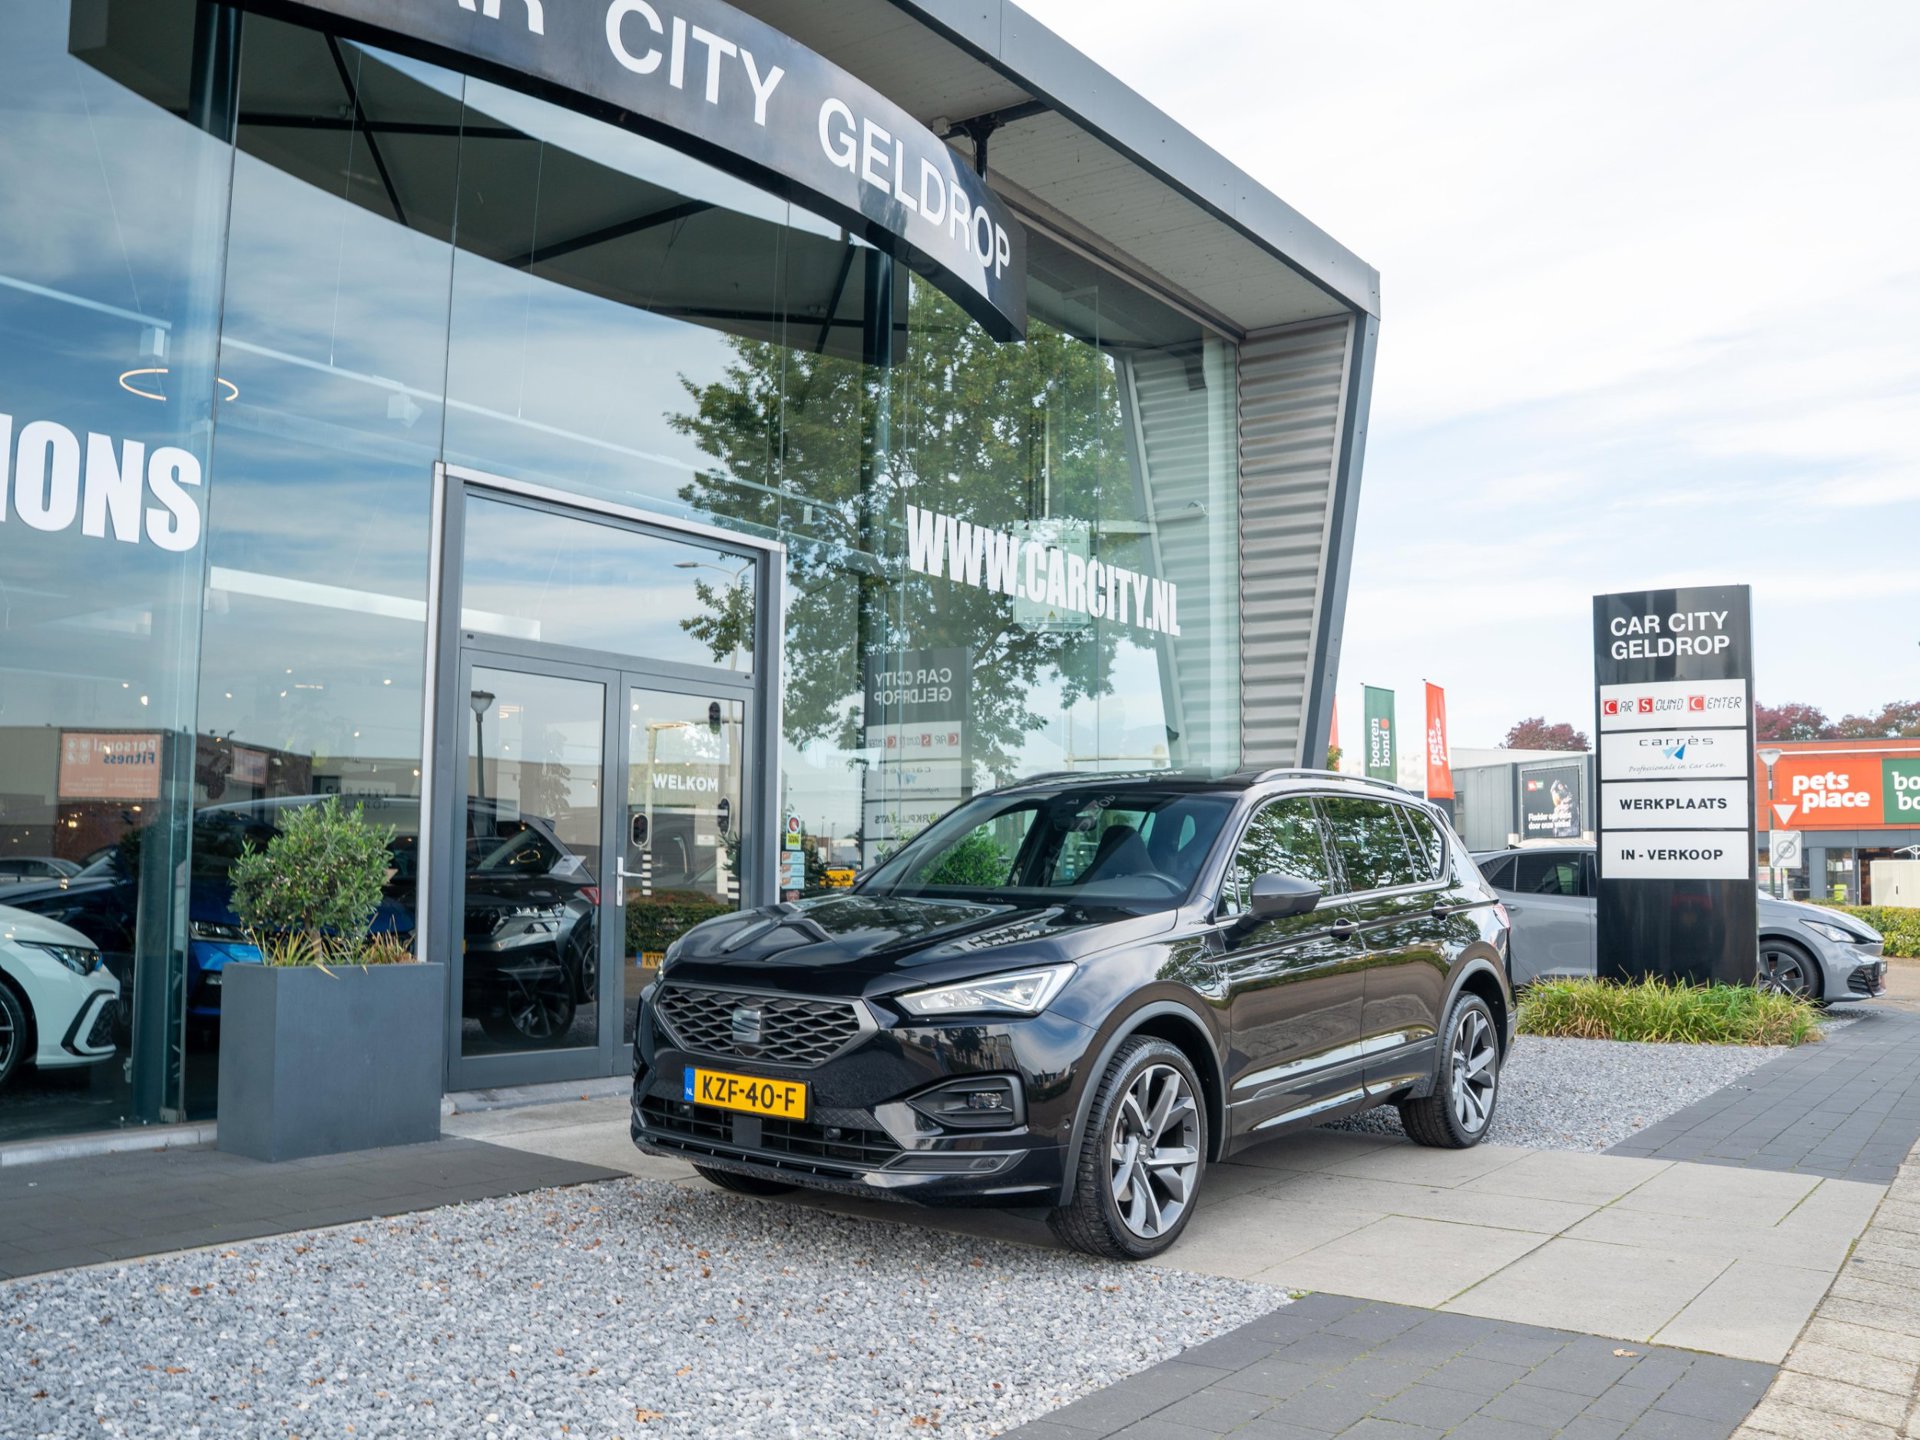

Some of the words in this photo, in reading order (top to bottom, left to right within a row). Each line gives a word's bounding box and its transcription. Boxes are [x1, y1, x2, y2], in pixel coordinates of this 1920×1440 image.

[605, 0, 785, 127] CITY
[818, 97, 1011, 279] GELDROP
[906, 504, 1181, 637] WWW.CARCITY.NL
[1610, 614, 1660, 637] CAR
[1668, 610, 1729, 633] CITY
[1611, 635, 1730, 660] GELDROP
[1638, 697, 1684, 713] SOUND
[1689, 695, 1742, 711] CENTER
[1369, 717, 1380, 768] boeren
[1379, 729, 1390, 767] bond
[652, 773, 719, 792] WELKOM
[1792, 771, 1849, 796] pets
[1620, 797, 1728, 810] WERKPLAATS
[1802, 790, 1871, 814] place
[1621, 849, 1635, 861] IN
[1648, 849, 1723, 861] VERKOOP
[685, 1087, 694, 1096] NL
[703, 1074, 797, 1112] KZF-40-F
